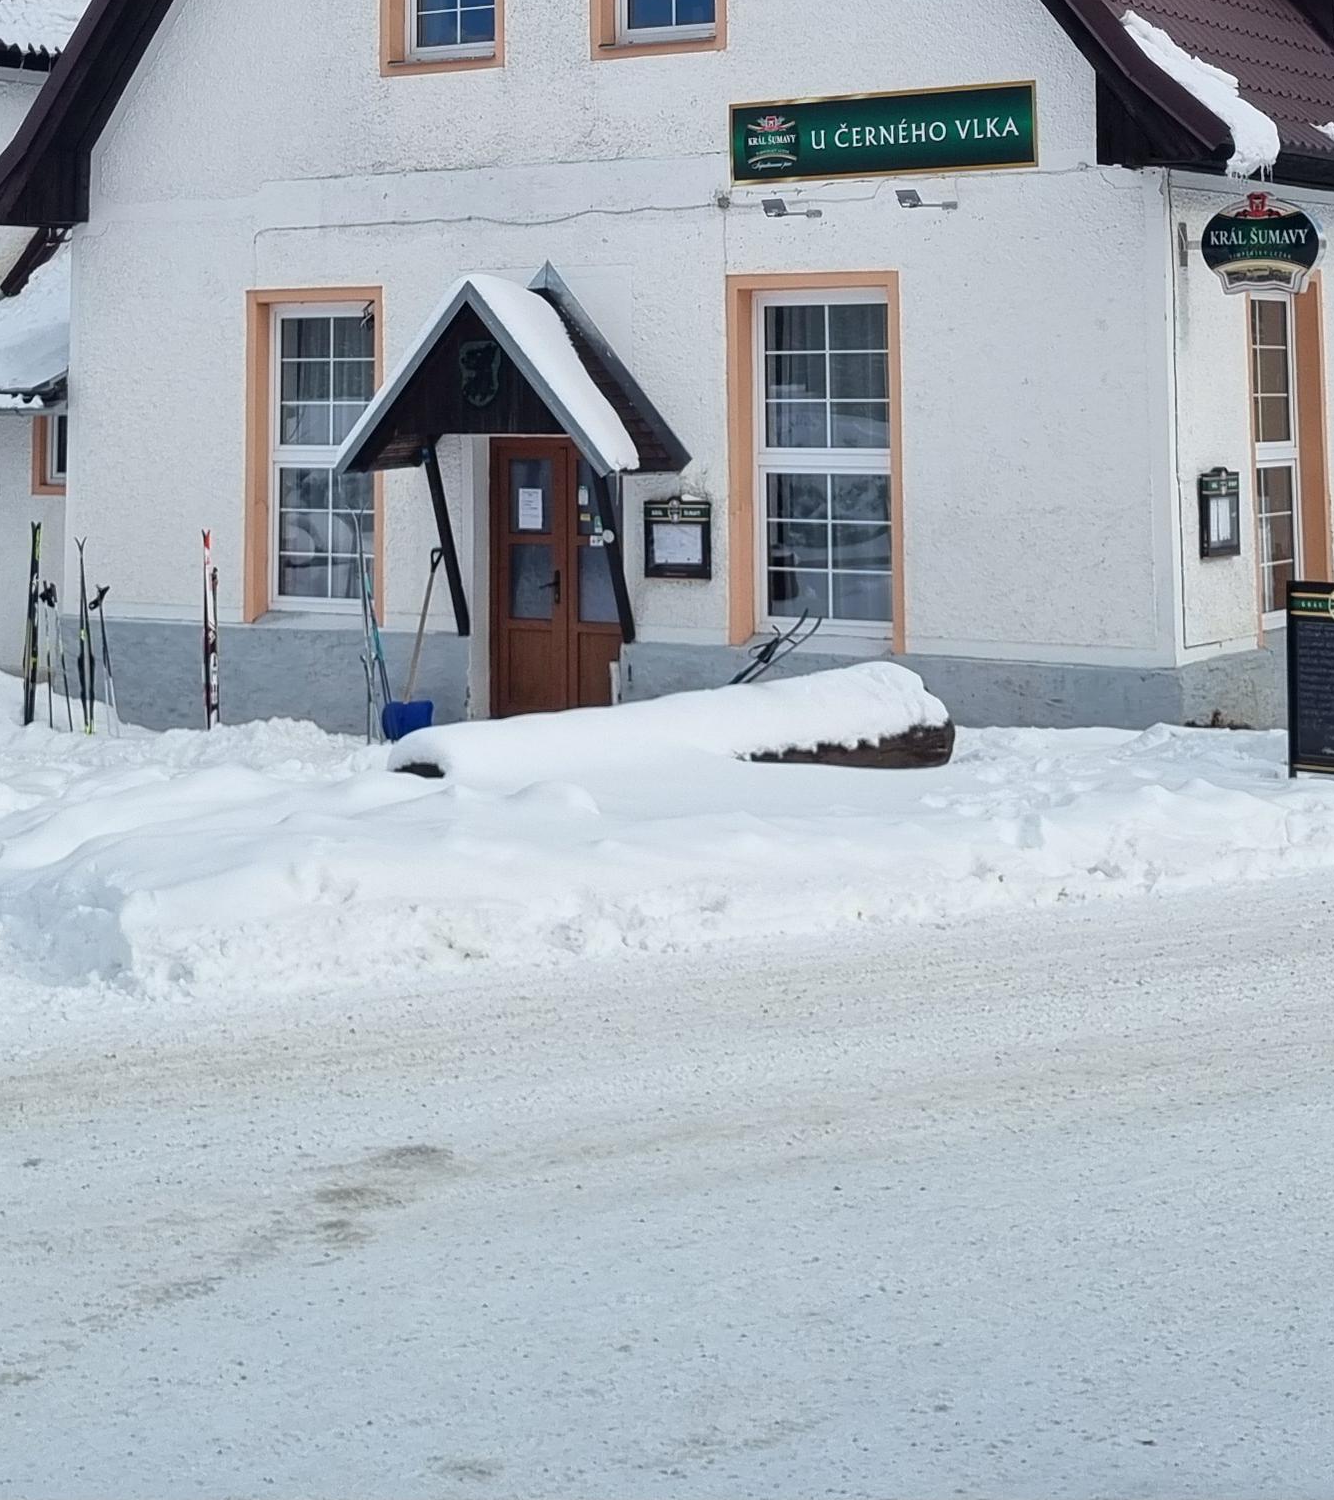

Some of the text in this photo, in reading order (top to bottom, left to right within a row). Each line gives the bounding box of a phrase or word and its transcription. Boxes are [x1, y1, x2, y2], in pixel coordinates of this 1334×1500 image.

[811, 116, 1020, 149] U ČERNÉHO VLKA
[1210, 226, 1308, 246] KRÁL ŠUMAVY
